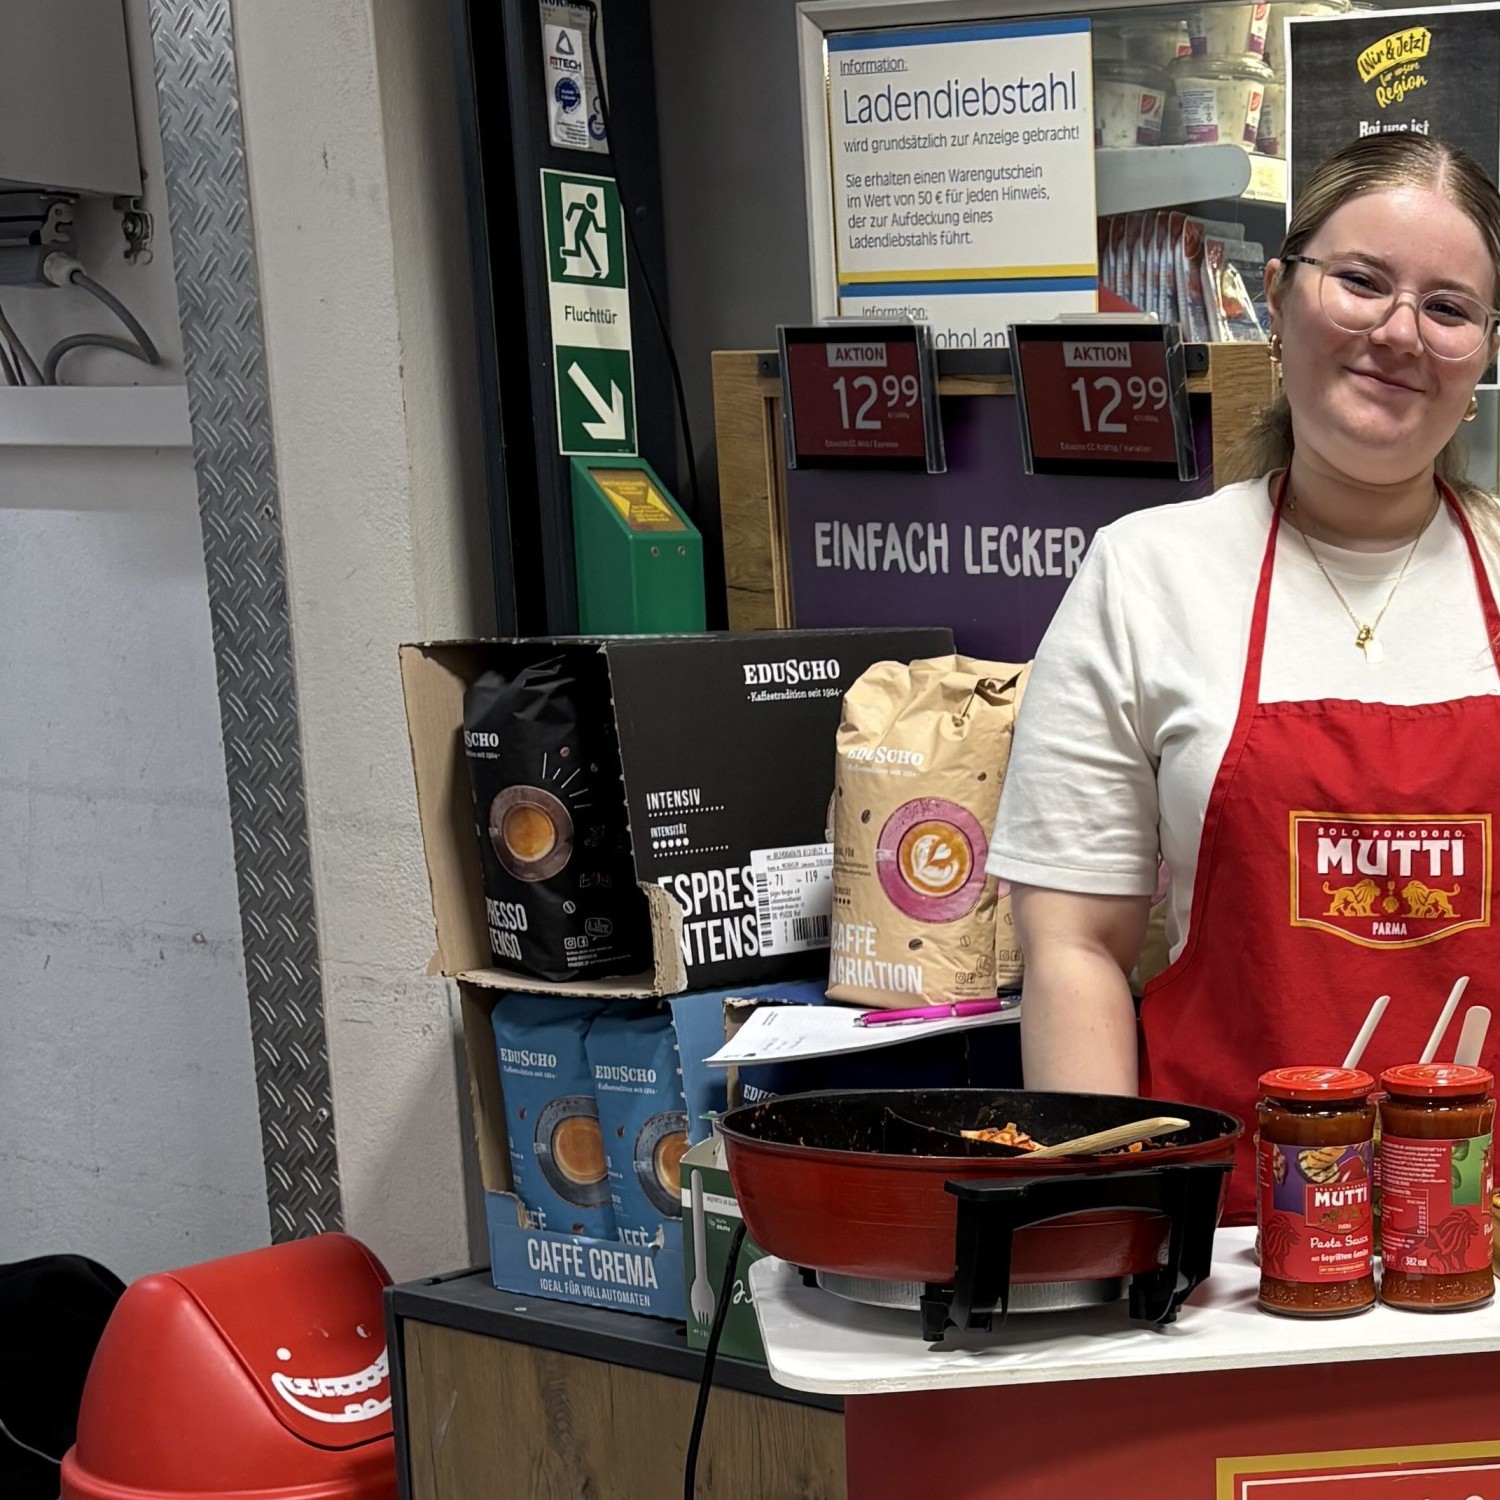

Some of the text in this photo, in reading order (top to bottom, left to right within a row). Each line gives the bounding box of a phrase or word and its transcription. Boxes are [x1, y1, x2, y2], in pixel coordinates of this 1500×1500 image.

[1360, 32, 1427, 75] Wir & Jetzt
[840, 57, 909, 75] Information:
[843, 71, 1077, 124] Ladendiebstahl
[1375, 75, 1428, 108] Region
[844, 126, 1080, 153] wird grundsätzlich zur Anzeige gebracht!
[846, 164, 1043, 188] Sie erhalten einen Warengutschein
[847, 185, 1050, 208] im Wert von 50 € für jeden Hinweis,
[848, 209, 993, 229] der zur Aufdeckung eines
[849, 230, 973, 249] Ladendiebstahls führt.
[564, 305, 618, 325] Fluchttür
[834, 346, 884, 363] AKTION
[1073, 346, 1128, 363] AKTION
[814, 520, 1086, 578] EINFACH LECKER
[743, 659, 840, 685] EDUSCHO
[465, 731, 499, 747] SCHO
[646, 788, 701, 810] INTENSIV
[650, 823, 687, 838] INTENSITÄT
[1317, 827, 1466, 838] SOLO POMODORO.
[1317, 838, 1465, 876] MUTTI
[485, 896, 528, 932] PRESSO
[1372, 922, 1408, 936] PARMA
[489, 927, 522, 961] TENSO
[500, 1048, 557, 1068] EDUSCHO
[595, 1065, 657, 1083] EDUSCHO
[1315, 1187, 1368, 1208] MUTTI
[1310, 1236, 1342, 1249] Pasta
[527, 1238, 658, 1289] CAFFÈ CREMA
[540, 1278, 651, 1307] IDEAL FÜR VOLLAUTOMATEN
